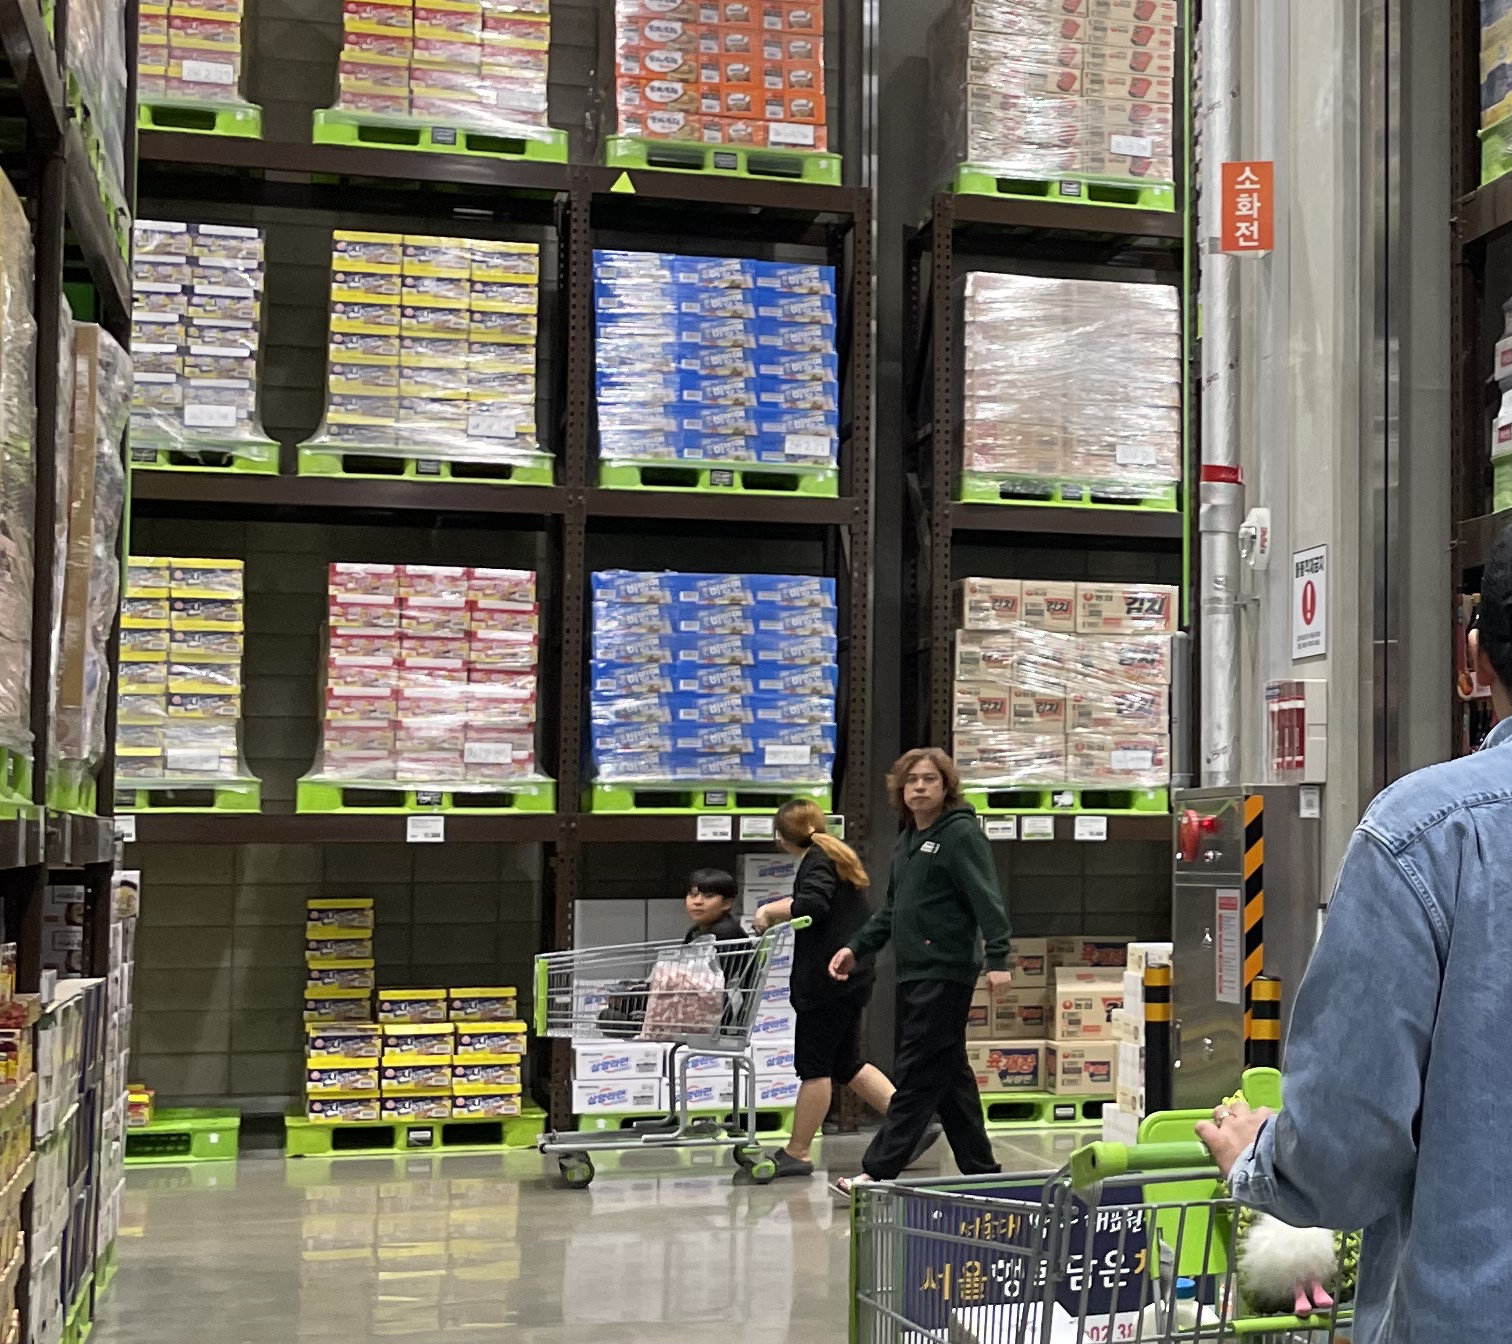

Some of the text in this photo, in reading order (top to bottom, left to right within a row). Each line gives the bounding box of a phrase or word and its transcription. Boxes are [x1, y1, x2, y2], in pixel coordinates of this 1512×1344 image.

[1235, 166, 1261, 246] 소화전
[1126, 596, 1165, 615] 김치
[1066, 1250, 1130, 1291] 담은
